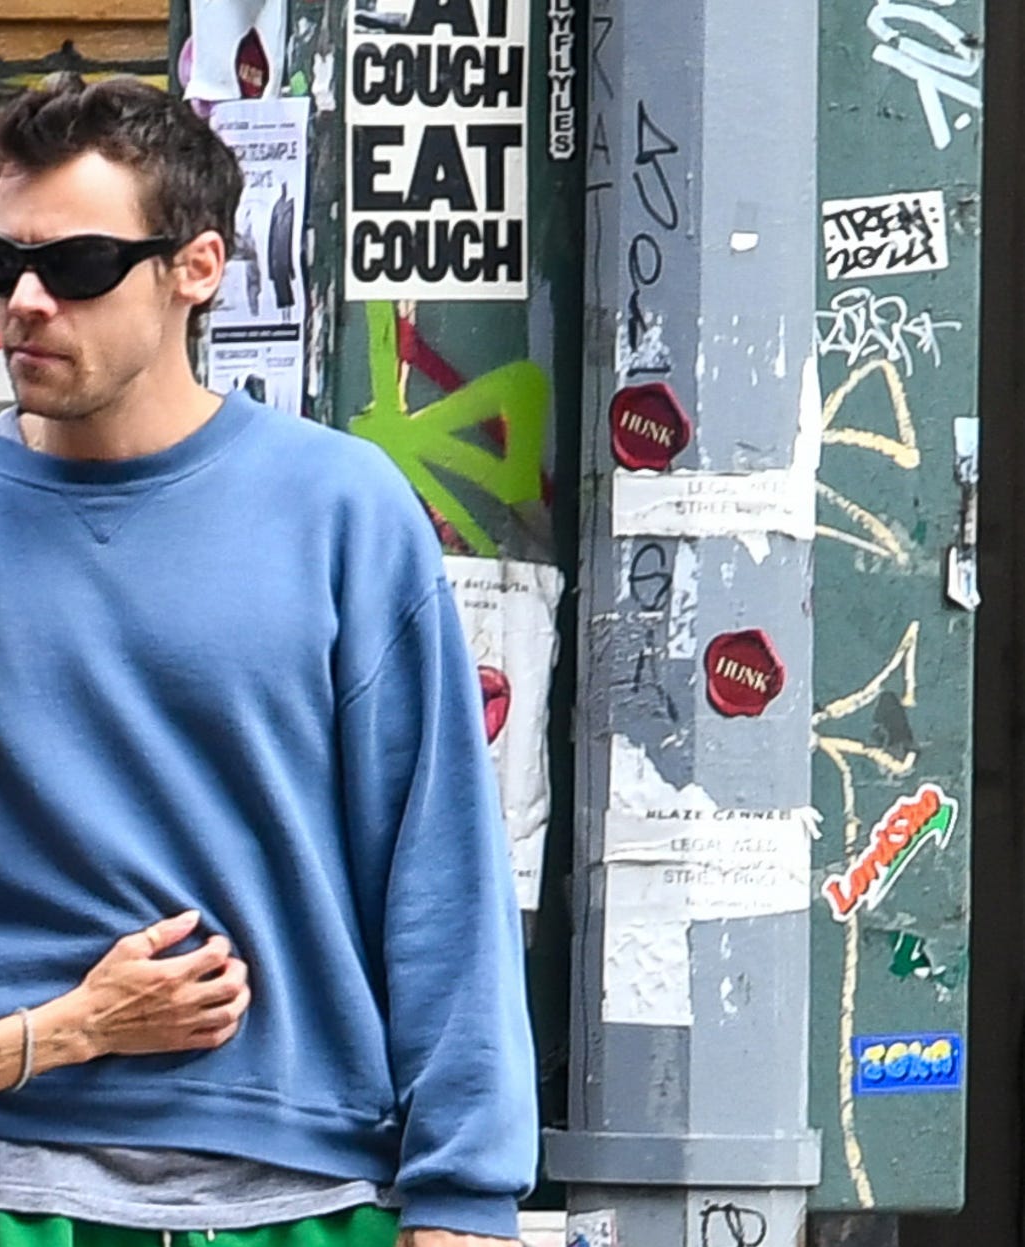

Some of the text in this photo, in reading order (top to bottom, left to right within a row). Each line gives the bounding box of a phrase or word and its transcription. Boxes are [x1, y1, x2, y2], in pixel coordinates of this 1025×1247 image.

[352, 42, 524, 108] COUCH
[352, 124, 523, 212] EAT
[352, 219, 523, 283] COUCH
[620, 410, 675, 448] HUNK
[715, 656, 770, 693] HUNK
